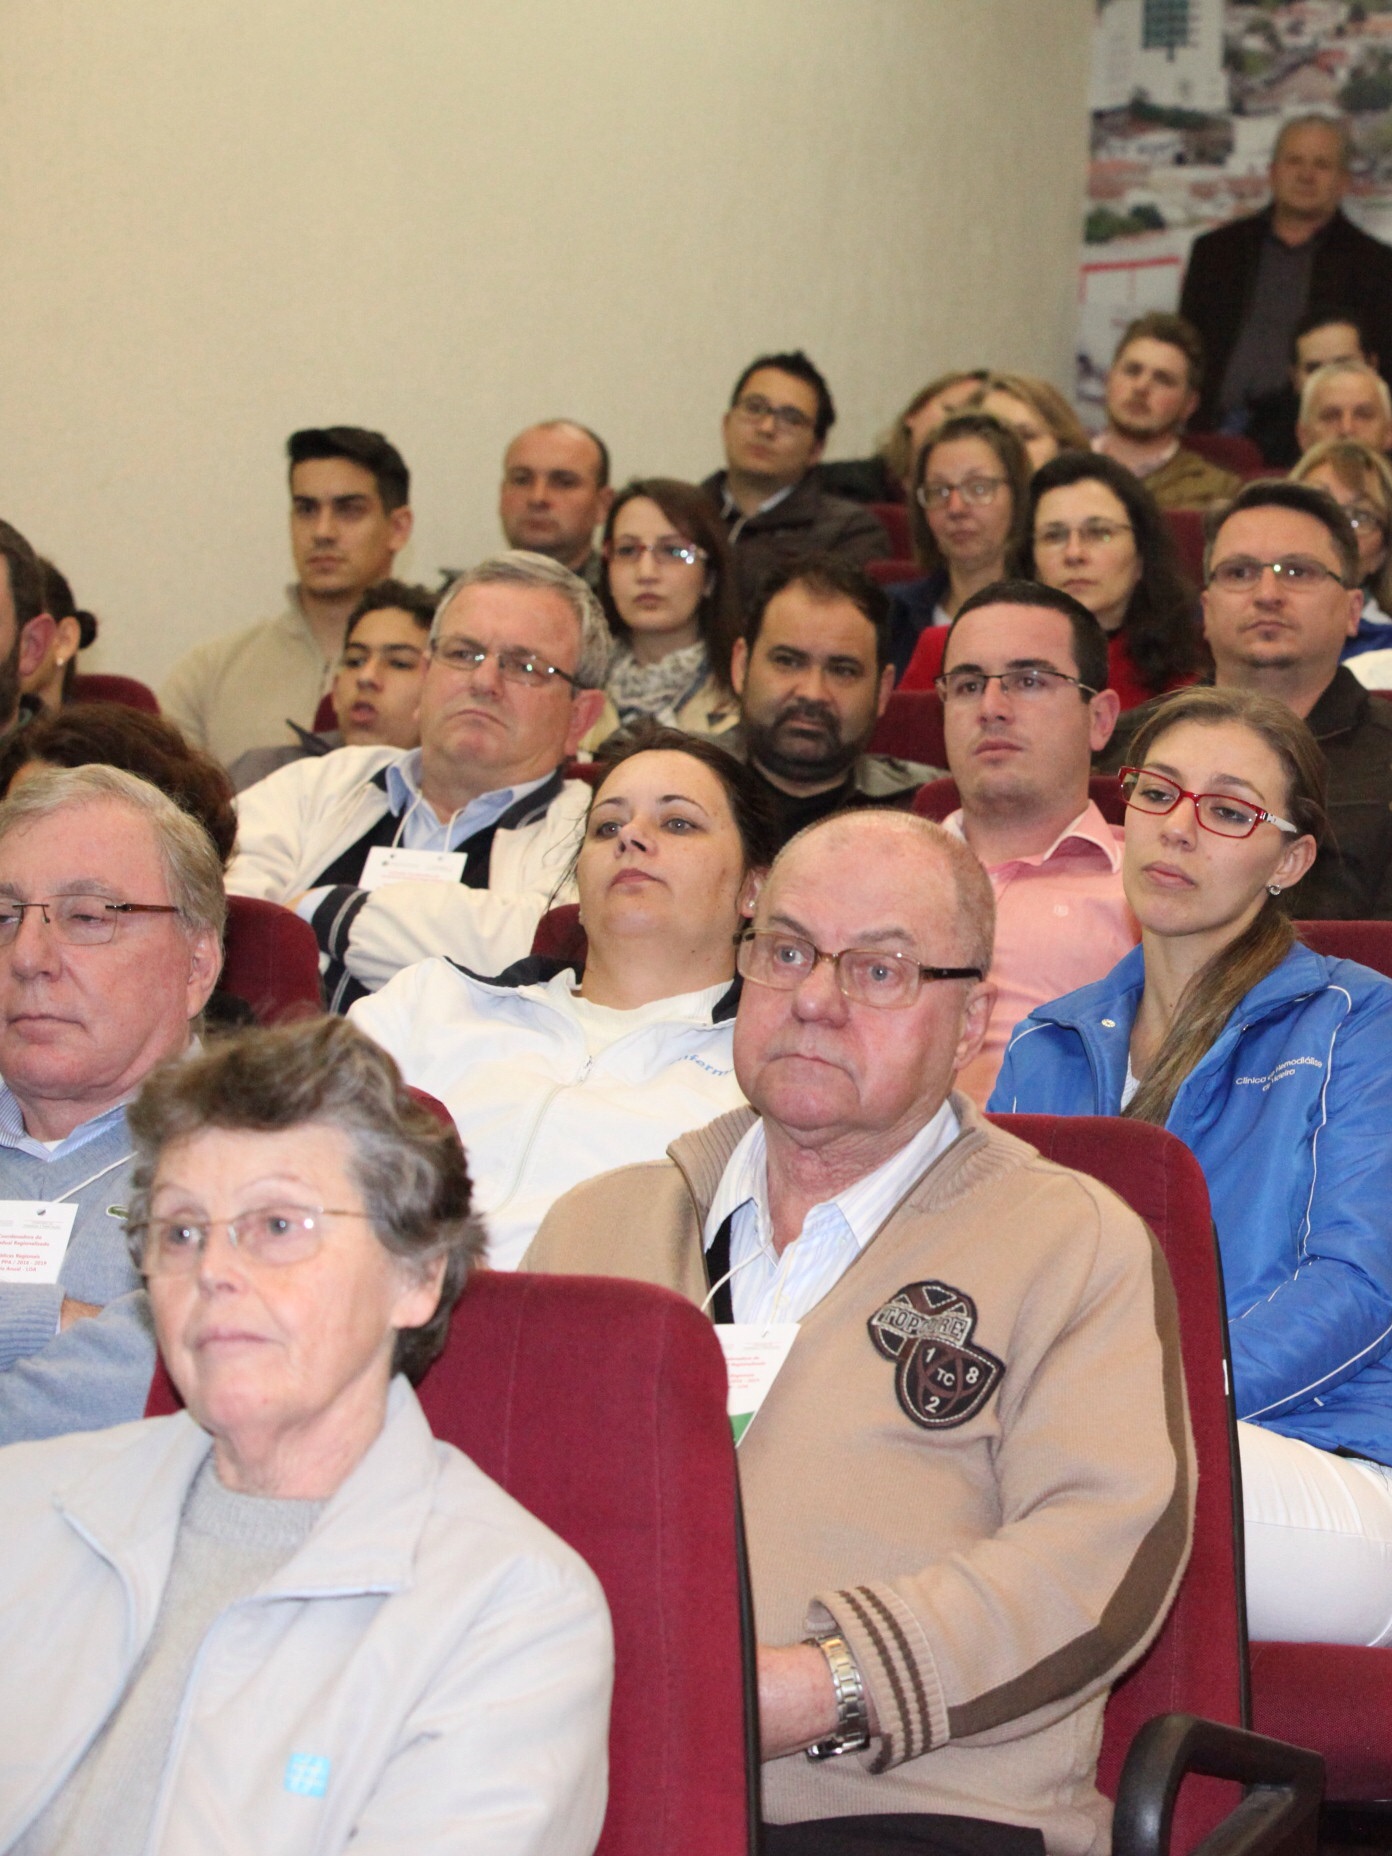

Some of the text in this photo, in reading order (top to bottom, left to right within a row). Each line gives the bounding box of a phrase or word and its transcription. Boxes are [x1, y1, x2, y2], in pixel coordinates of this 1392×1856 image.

[925, 1347, 936, 1363] 1
[936, 1368, 956, 1386] TC
[965, 1366, 980, 1384] 8
[925, 1396, 940, 1413] 2
